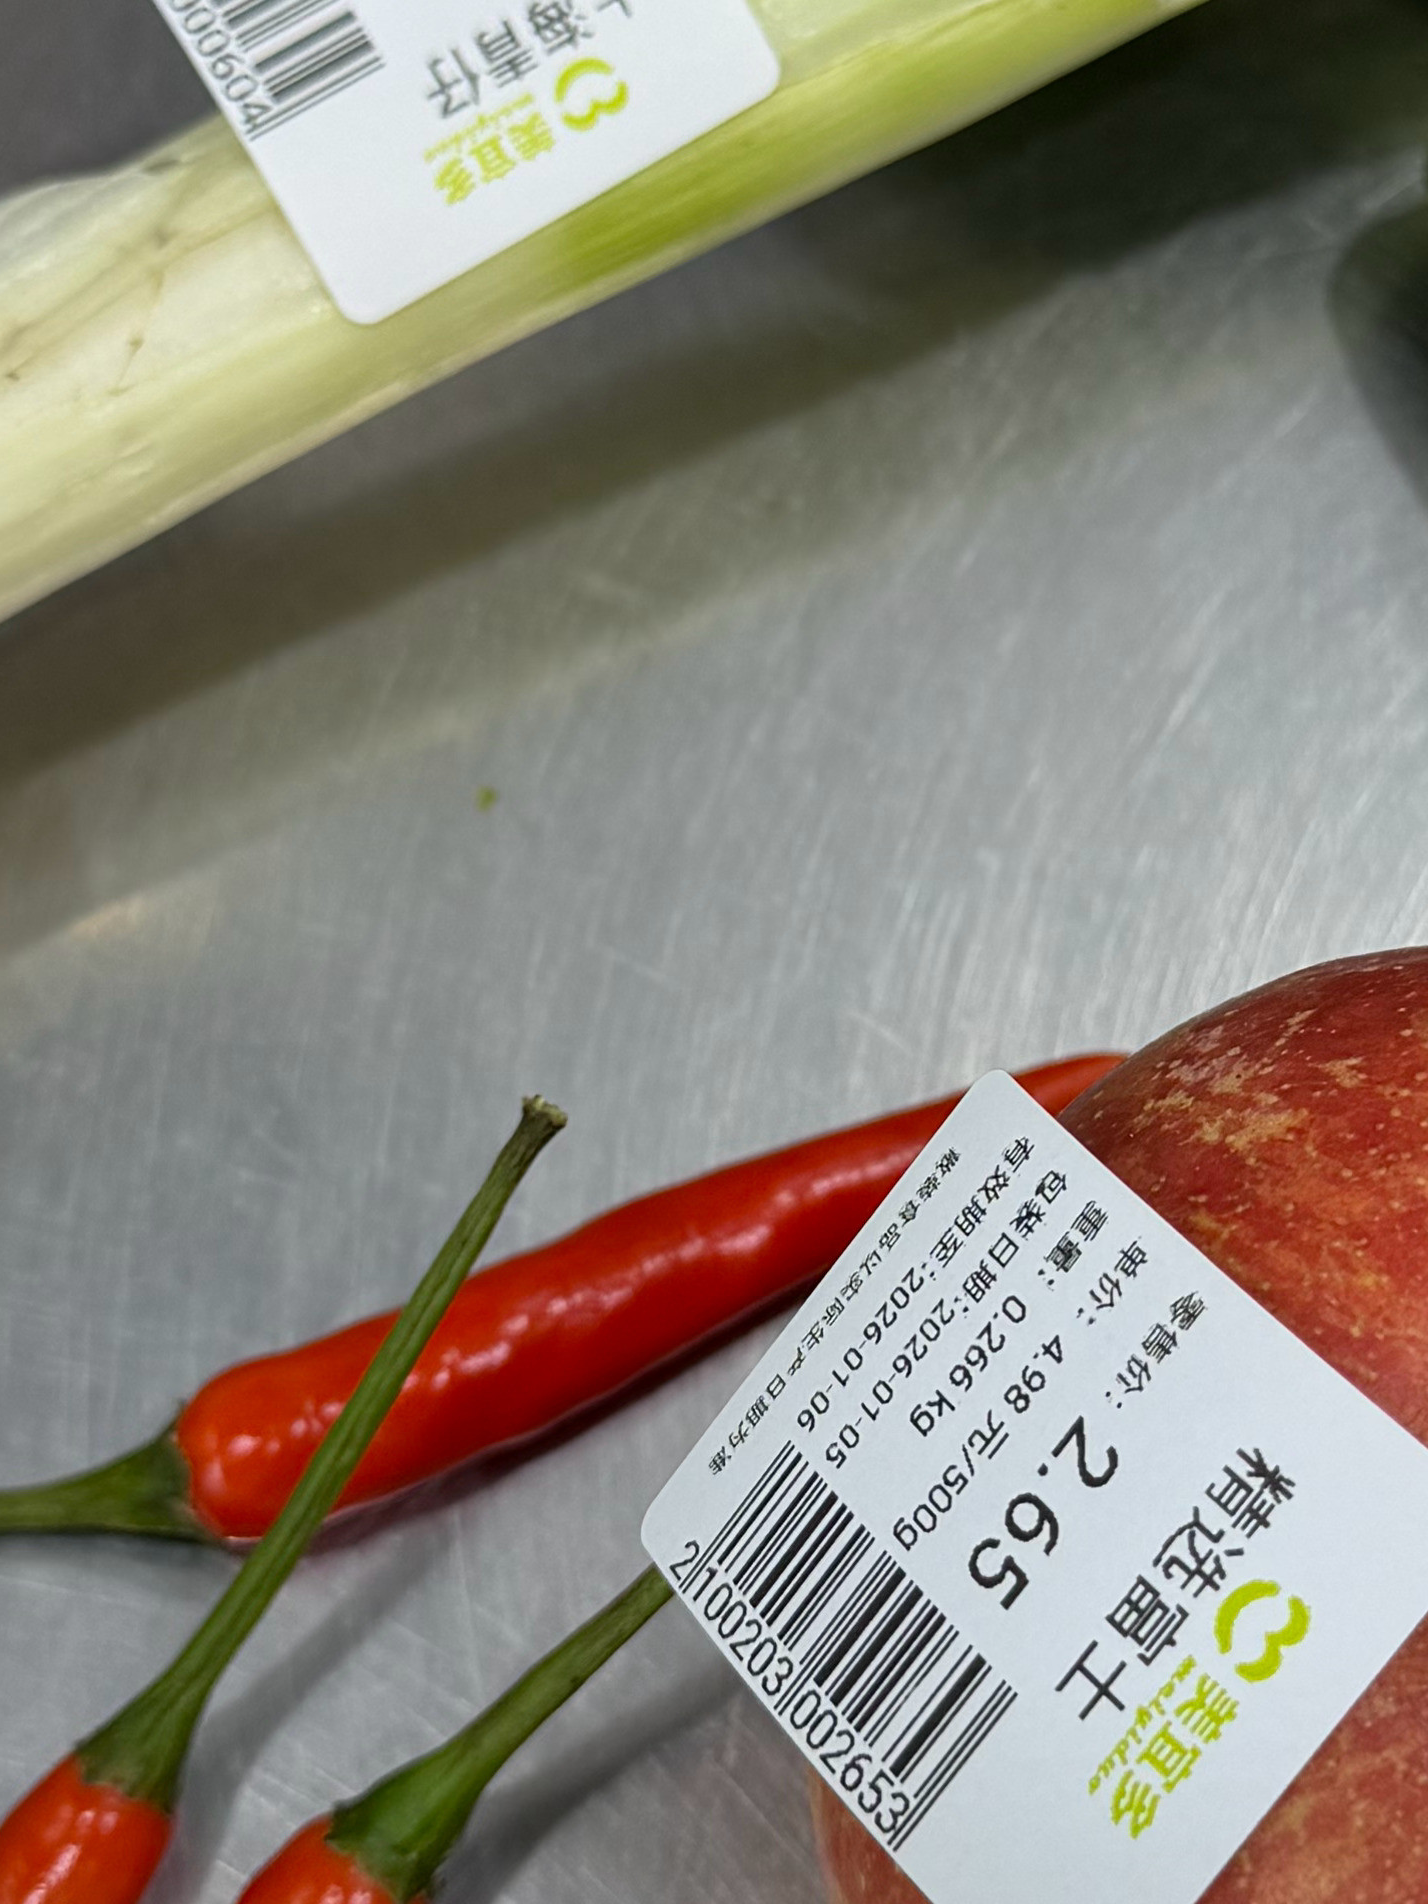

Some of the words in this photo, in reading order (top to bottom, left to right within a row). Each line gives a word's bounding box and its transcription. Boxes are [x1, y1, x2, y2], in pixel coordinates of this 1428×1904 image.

[1036, 1198, 1110, 1288] 重量：
[1075, 1239, 1150, 1327] 单价：
[706, 1147, 961, 1477] 散装食品以实际生产日期为准
[947, 1293, 1028, 1394] 0.266
[1103, 1290, 1207, 1411] 零售价：
[908, 1388, 958, 1439] kg
[1002, 1333, 1065, 1416] 4.98
[891, 1407, 1011, 1553] 元/500g
[966, 1413, 1120, 1612] 2.65
[1053, 1446, 1298, 1723] 精选富士
[1110, 1674, 1238, 1841] 美宜多
